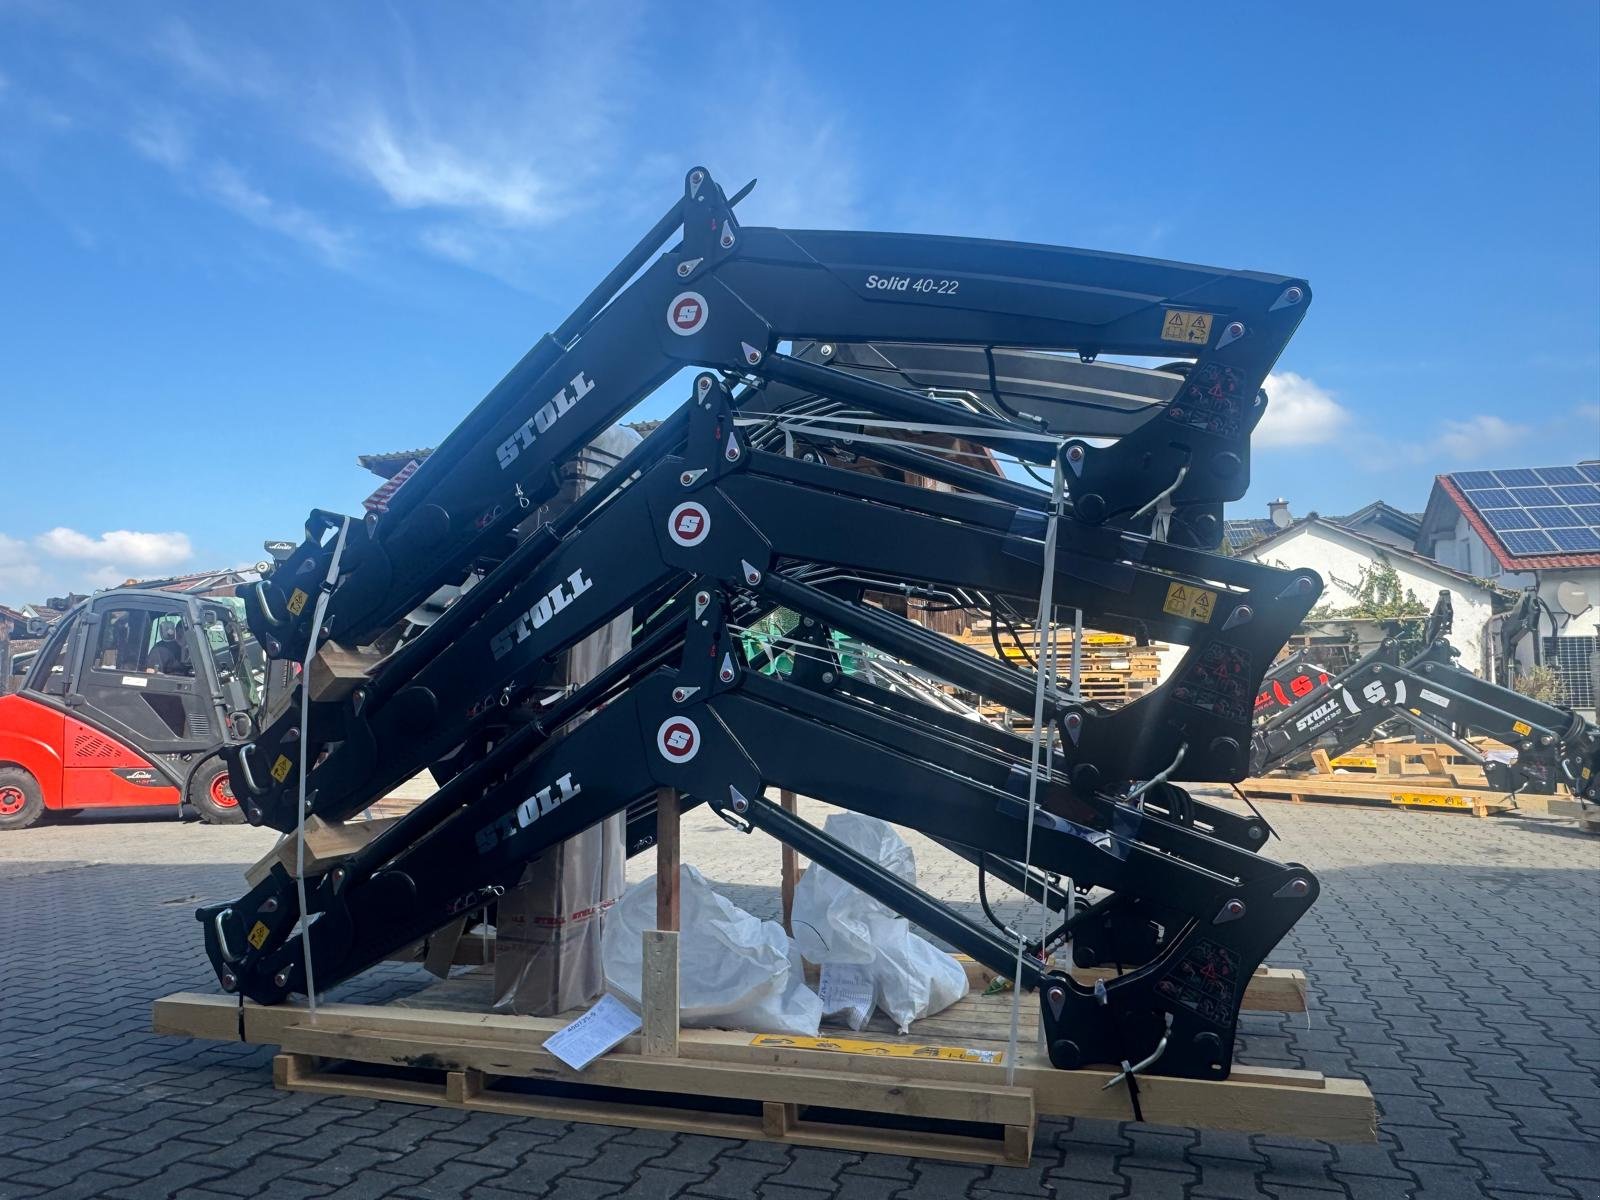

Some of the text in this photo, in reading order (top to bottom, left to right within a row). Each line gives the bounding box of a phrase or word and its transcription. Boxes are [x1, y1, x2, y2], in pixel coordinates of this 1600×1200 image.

[866, 275, 959, 295] Solid 40-22
[496, 371, 595, 470] STOLL
[490, 568, 593, 661] STOLL
[1296, 698, 1339, 732] STOLL
[475, 772, 581, 854] STOLL
